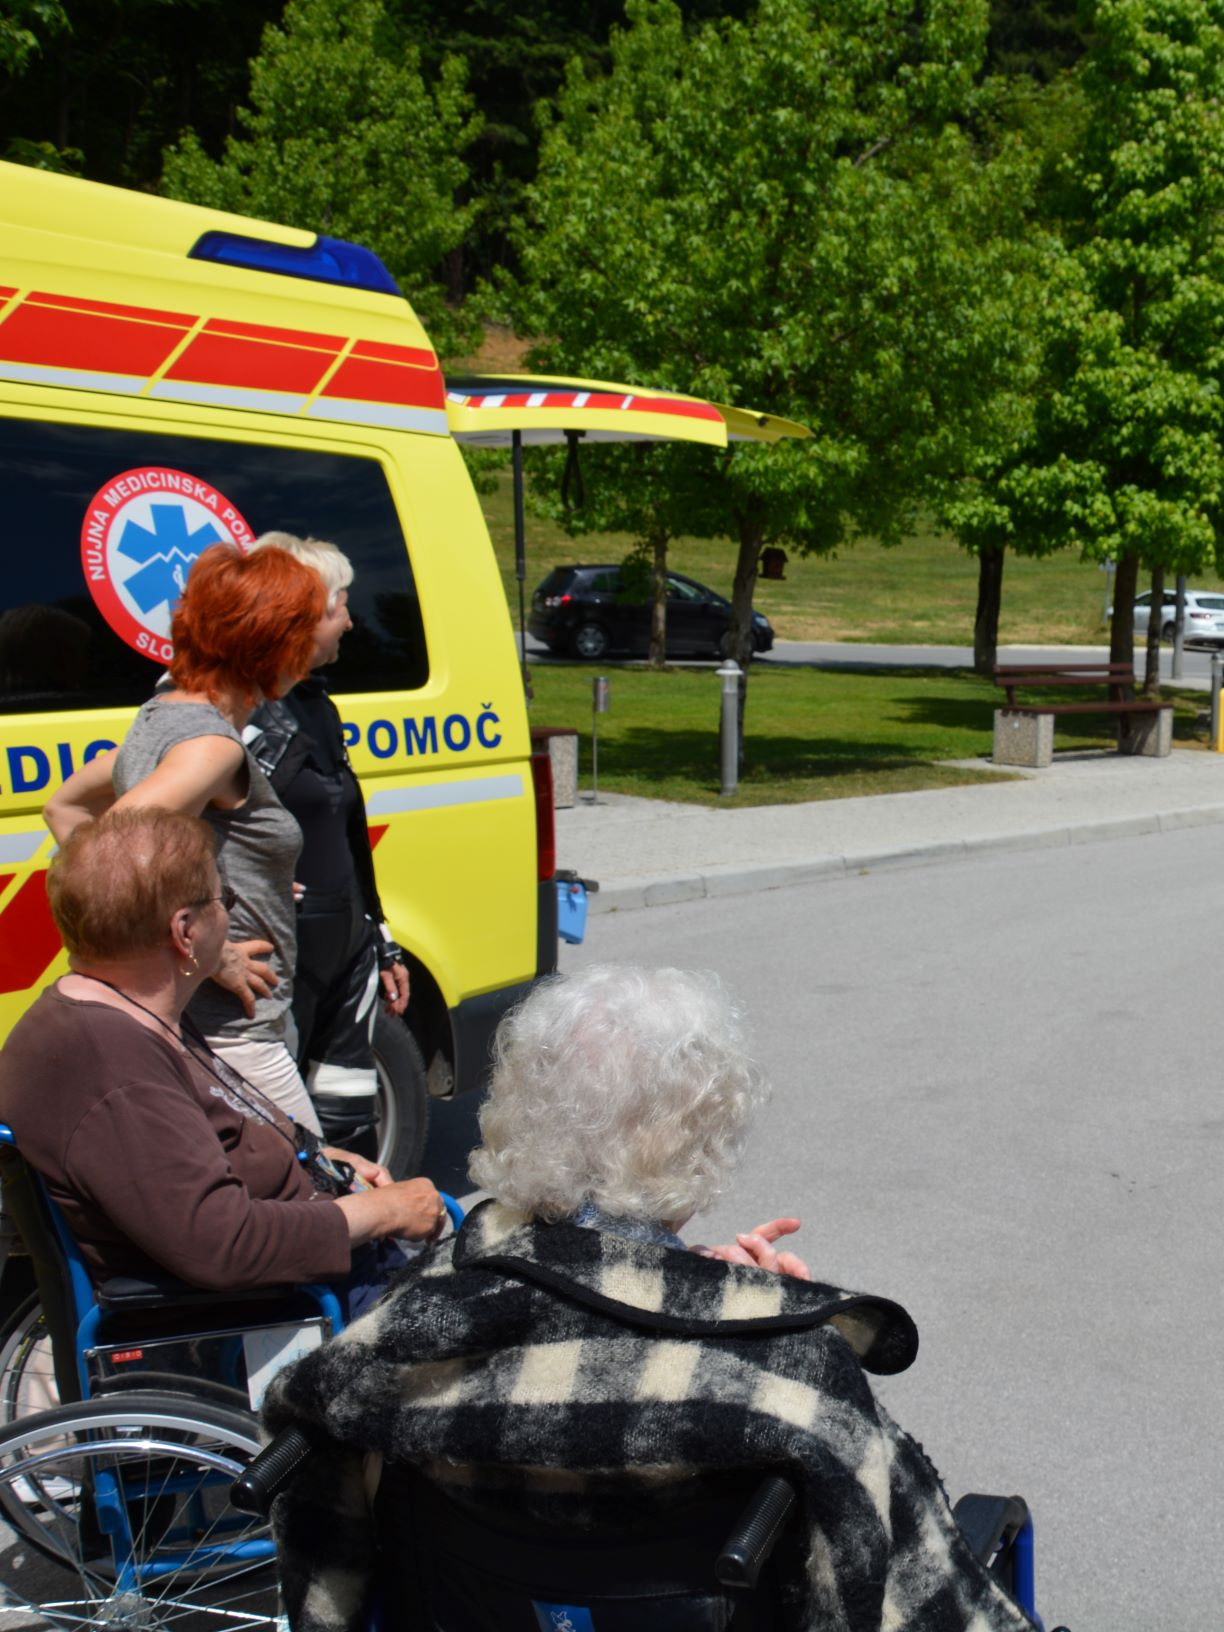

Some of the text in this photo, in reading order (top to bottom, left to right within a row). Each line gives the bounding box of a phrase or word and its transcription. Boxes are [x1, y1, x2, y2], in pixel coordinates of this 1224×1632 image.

[86, 508, 110, 581] NUJNA
[103, 472, 219, 510] MEDICINSKA
[342, 702, 502, 759] POMOČ
